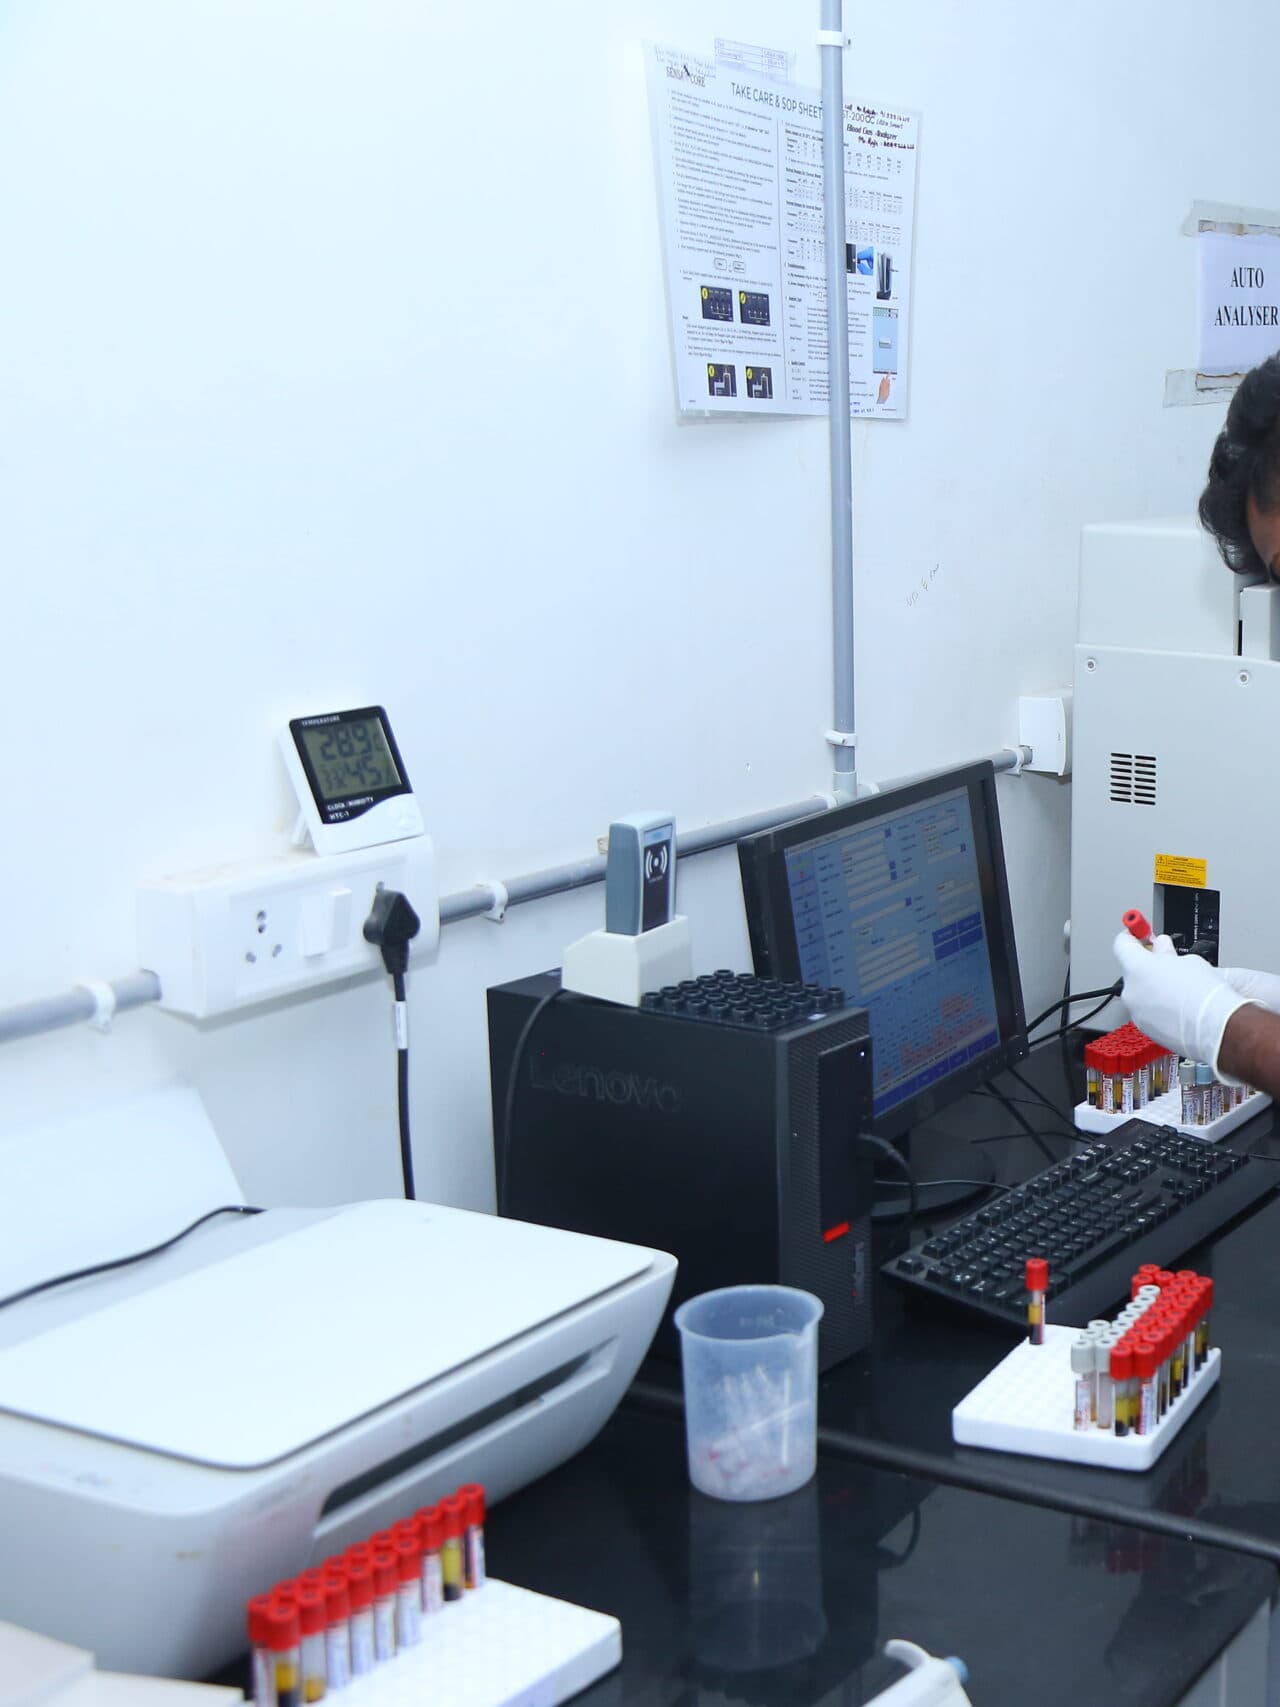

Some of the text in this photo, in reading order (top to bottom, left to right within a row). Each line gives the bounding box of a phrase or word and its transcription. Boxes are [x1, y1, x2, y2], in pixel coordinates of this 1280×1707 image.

[731, 82, 751, 100] TAKE
[753, 88, 773, 107] CARE
[782, 97, 797, 112] SOP
[1230, 266, 1265, 288] AUTO
[1214, 305, 1279, 326] ANALYSER
